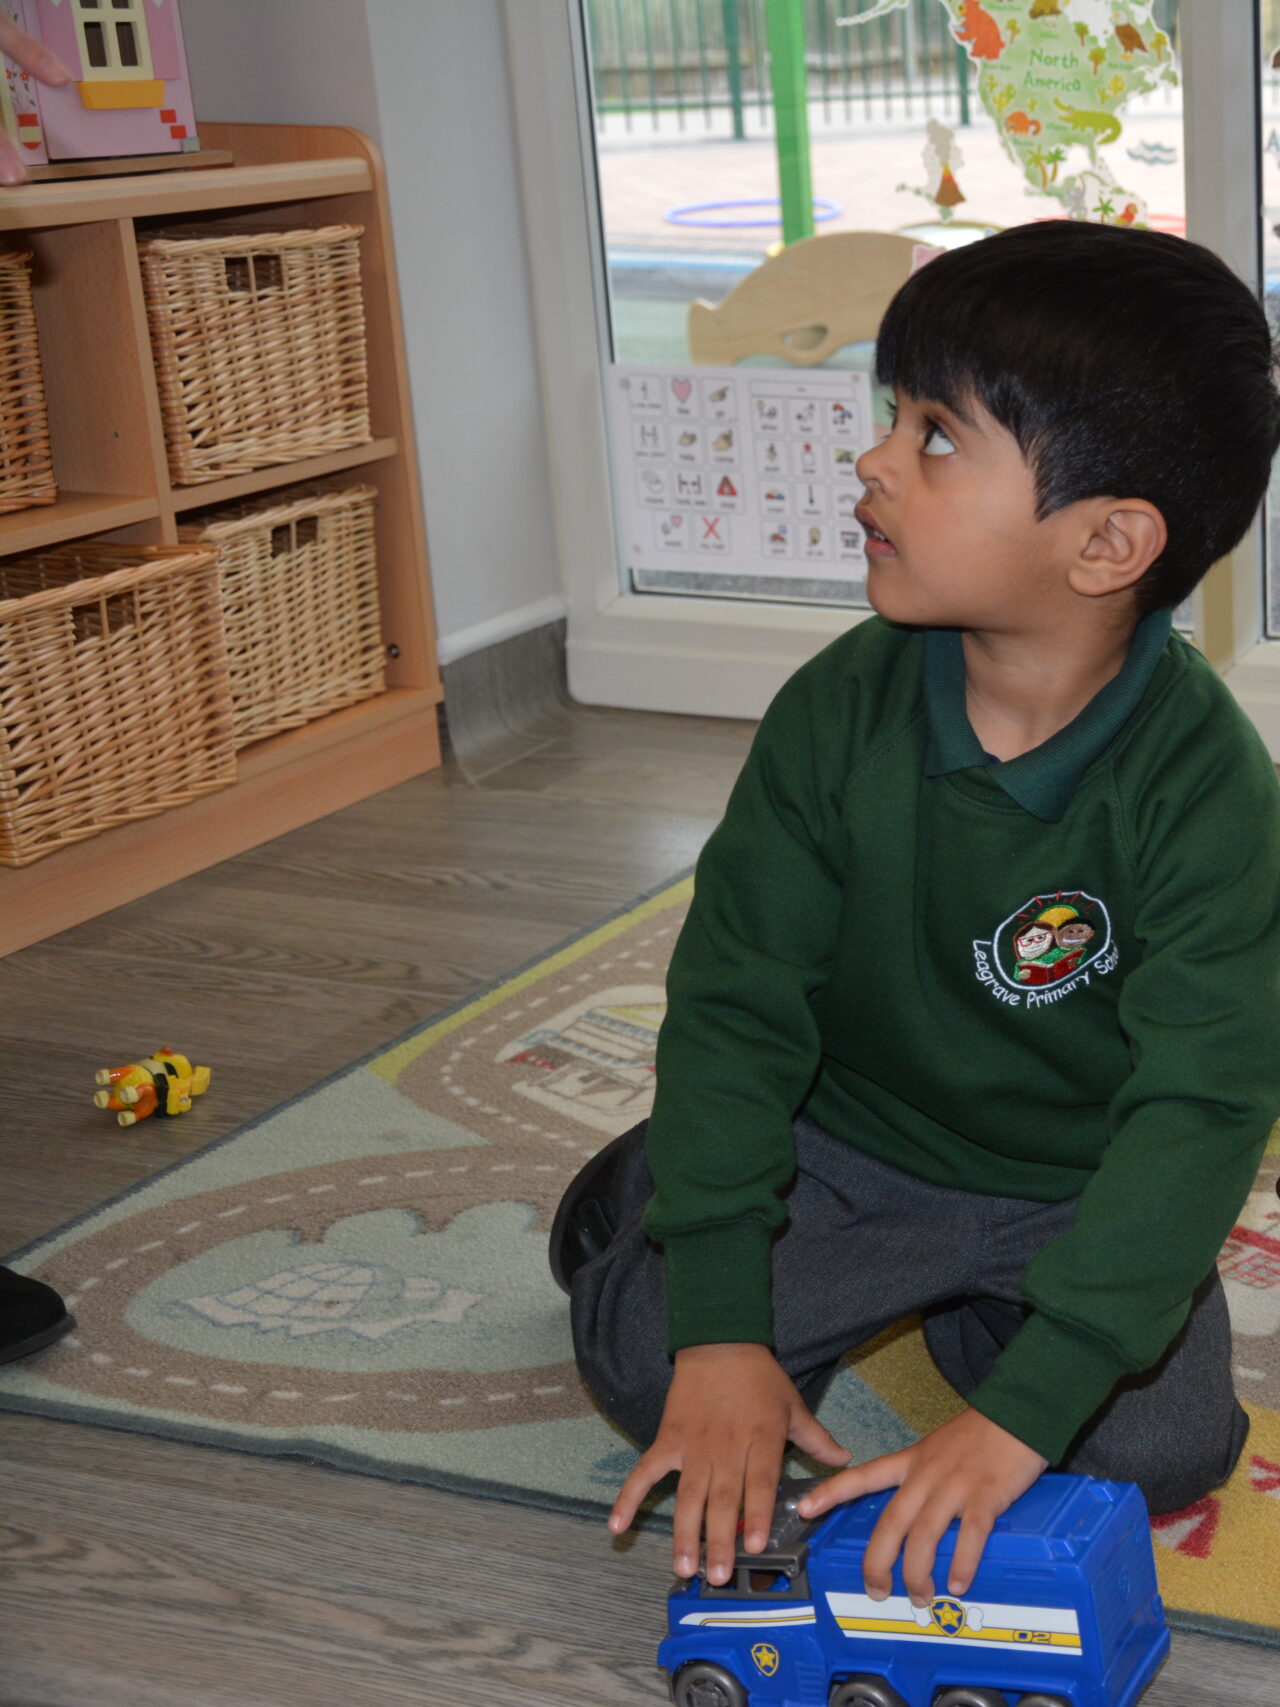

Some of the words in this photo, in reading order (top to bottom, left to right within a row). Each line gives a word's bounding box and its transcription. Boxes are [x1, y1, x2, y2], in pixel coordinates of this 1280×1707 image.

[1029, 50, 1079, 69] North
[1023, 71, 1081, 92] America
[973, 939, 1021, 1006] Leagrave
[1026, 971, 1091, 1009] Primary
[1013, 1629, 1051, 1645] 02
